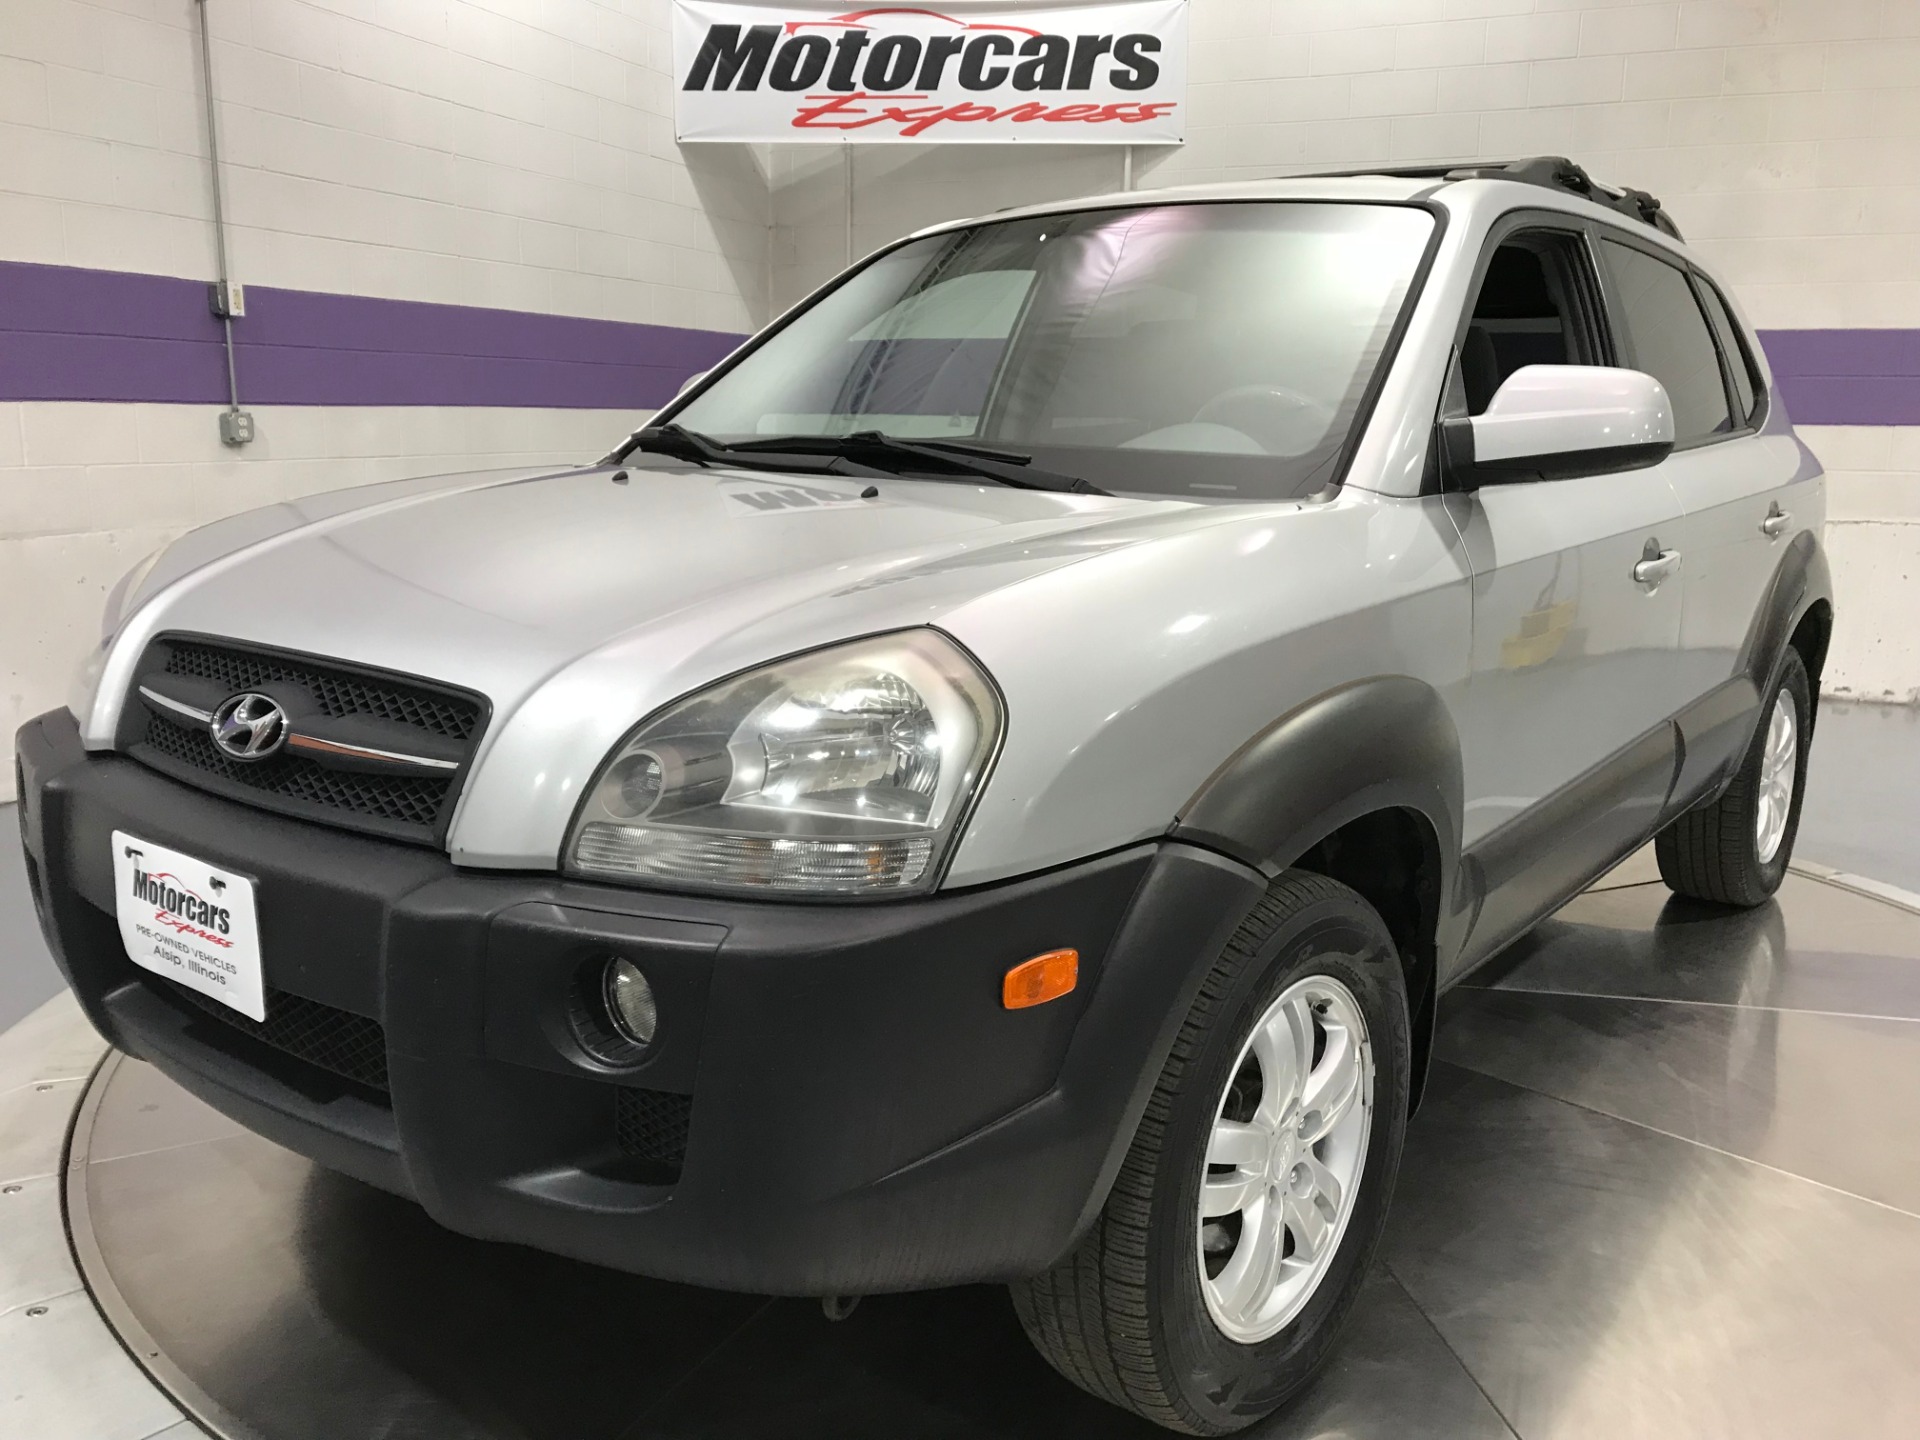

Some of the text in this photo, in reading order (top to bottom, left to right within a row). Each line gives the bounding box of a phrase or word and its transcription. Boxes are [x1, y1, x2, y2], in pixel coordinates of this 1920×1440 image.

[682, 24, 1162, 91] Motorcars
[791, 92, 1178, 136] Express
[133, 869, 231, 935] Motorcars
[136, 924, 237, 975] PRE-OWNED VEHICLES
[154, 908, 235, 948] Express
[153, 945, 226, 985] Alsip, Illinois
